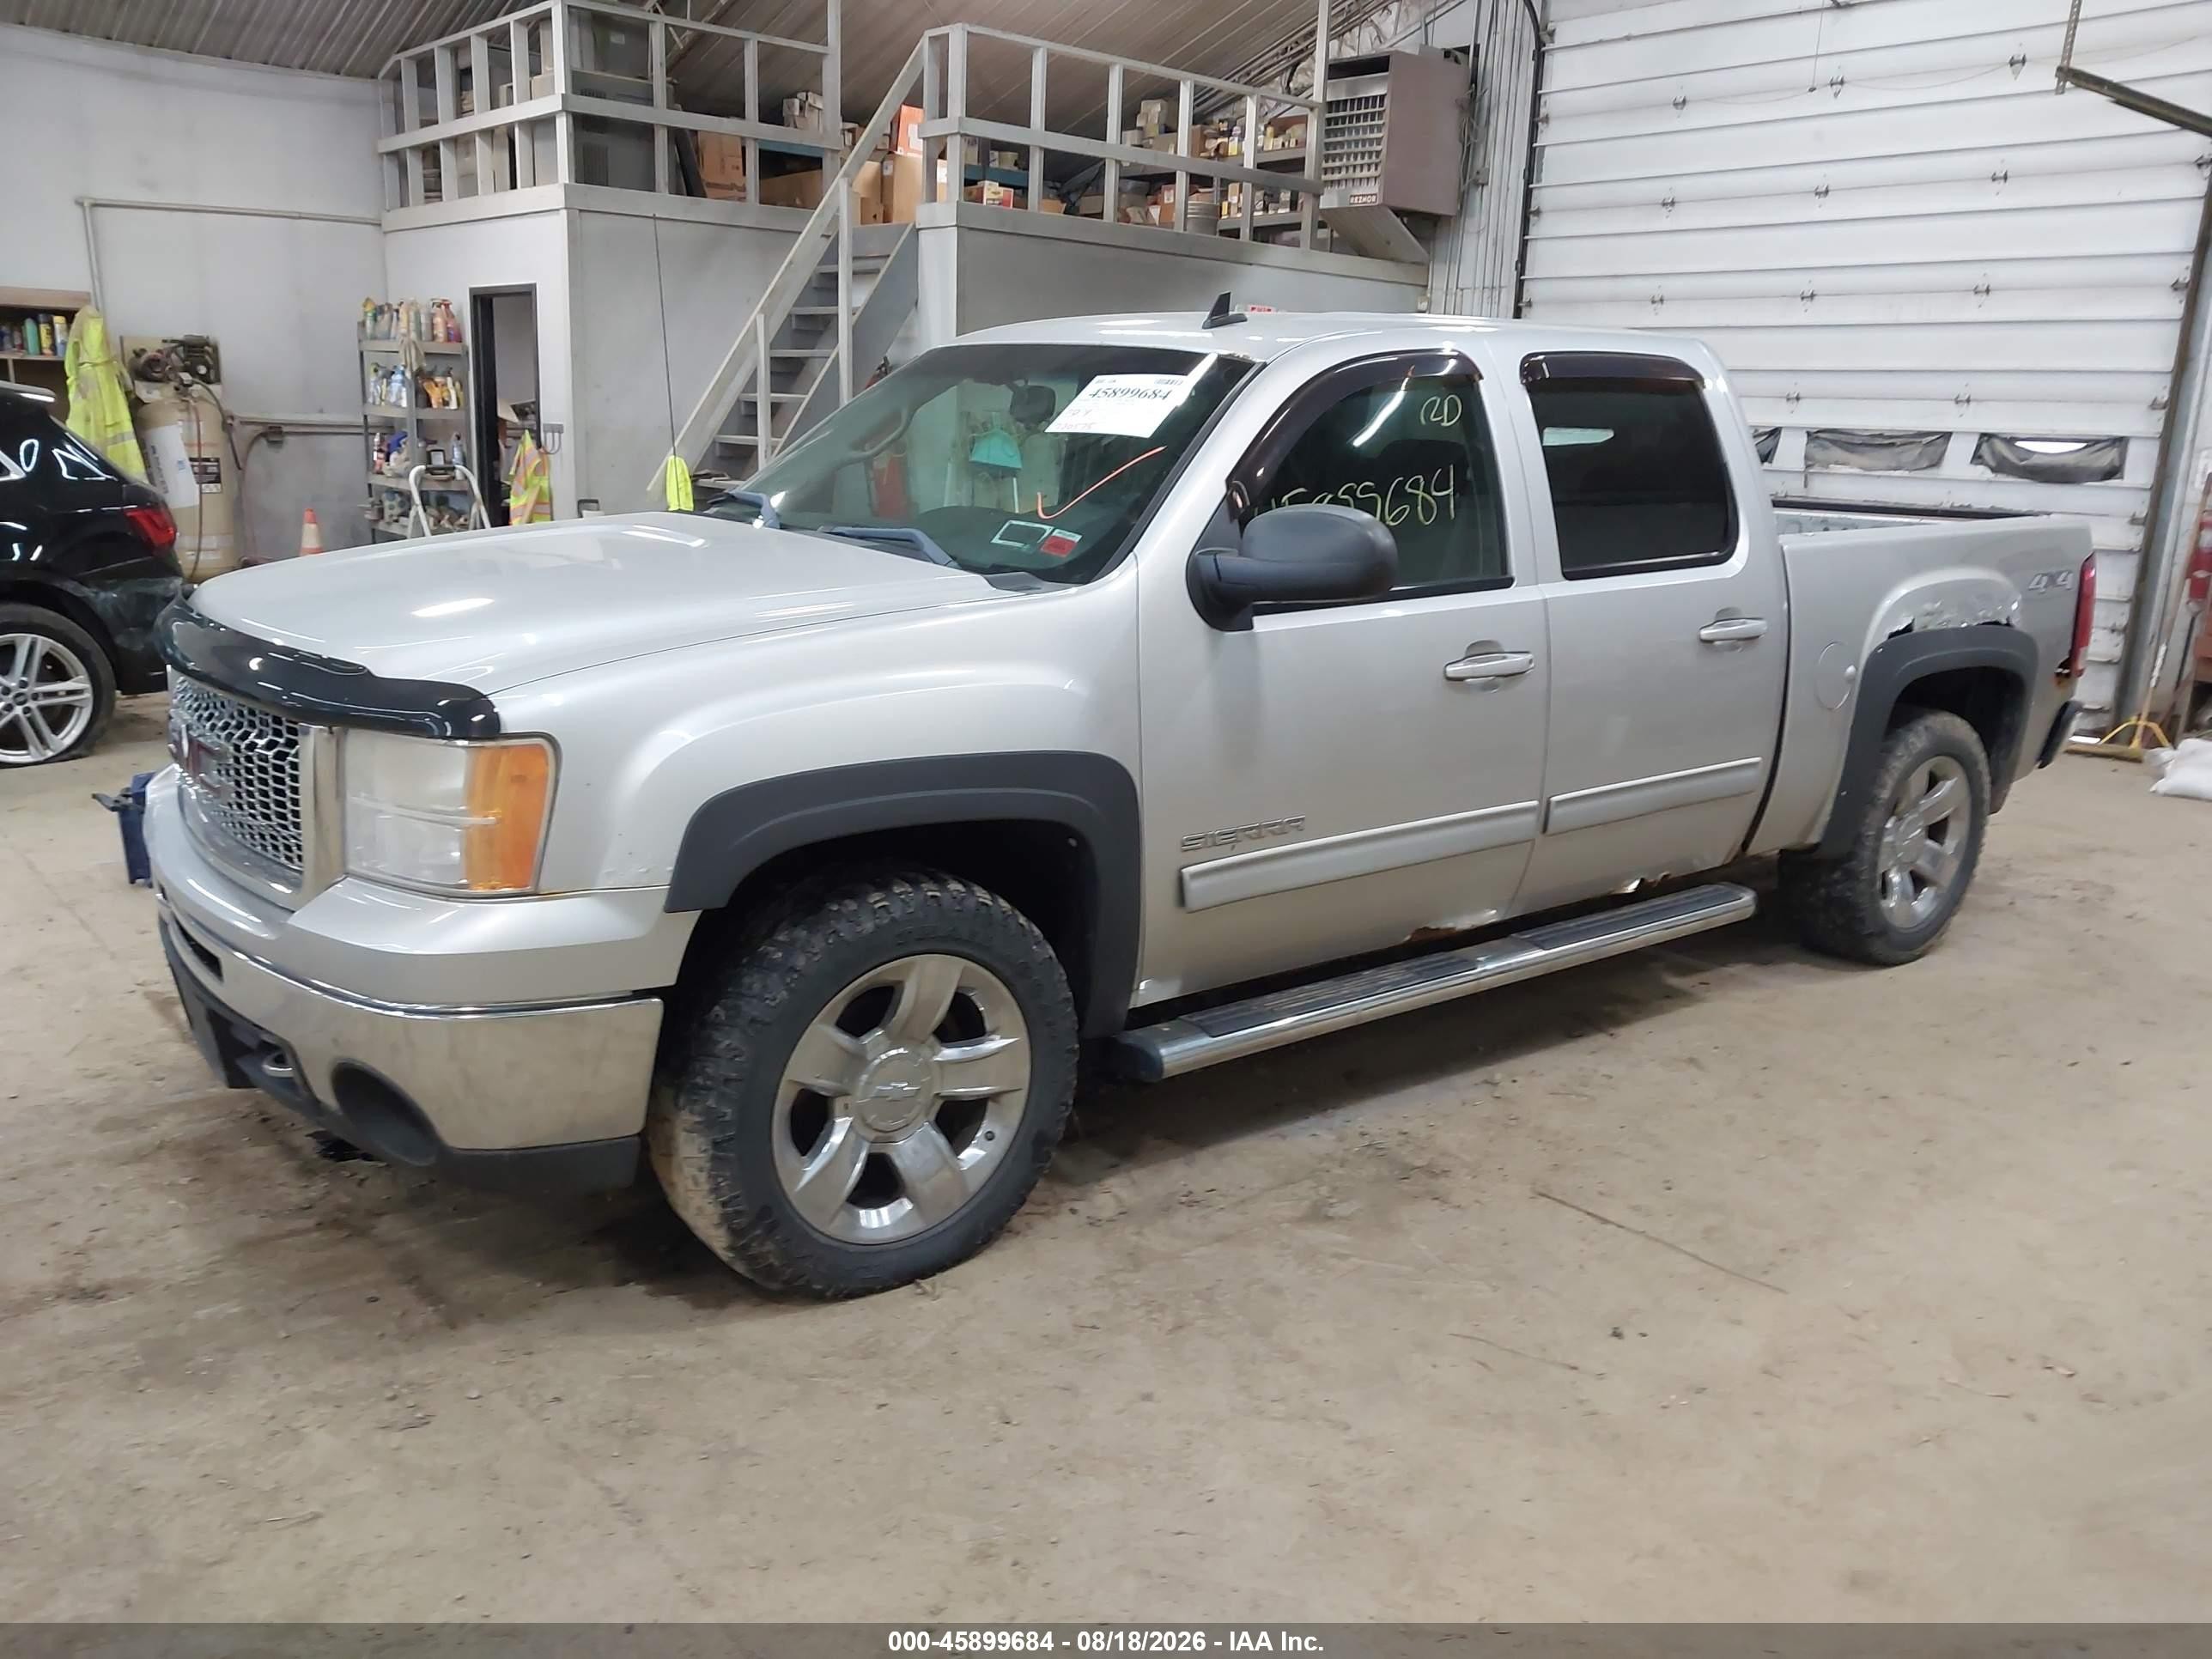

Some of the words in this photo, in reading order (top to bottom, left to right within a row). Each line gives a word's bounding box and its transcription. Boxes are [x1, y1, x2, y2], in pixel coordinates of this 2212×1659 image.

[1089, 386, 1174, 401] 45899684
[1254, 464, 1455, 526] 99684
[1181, 815, 1306, 852] SIERRA
